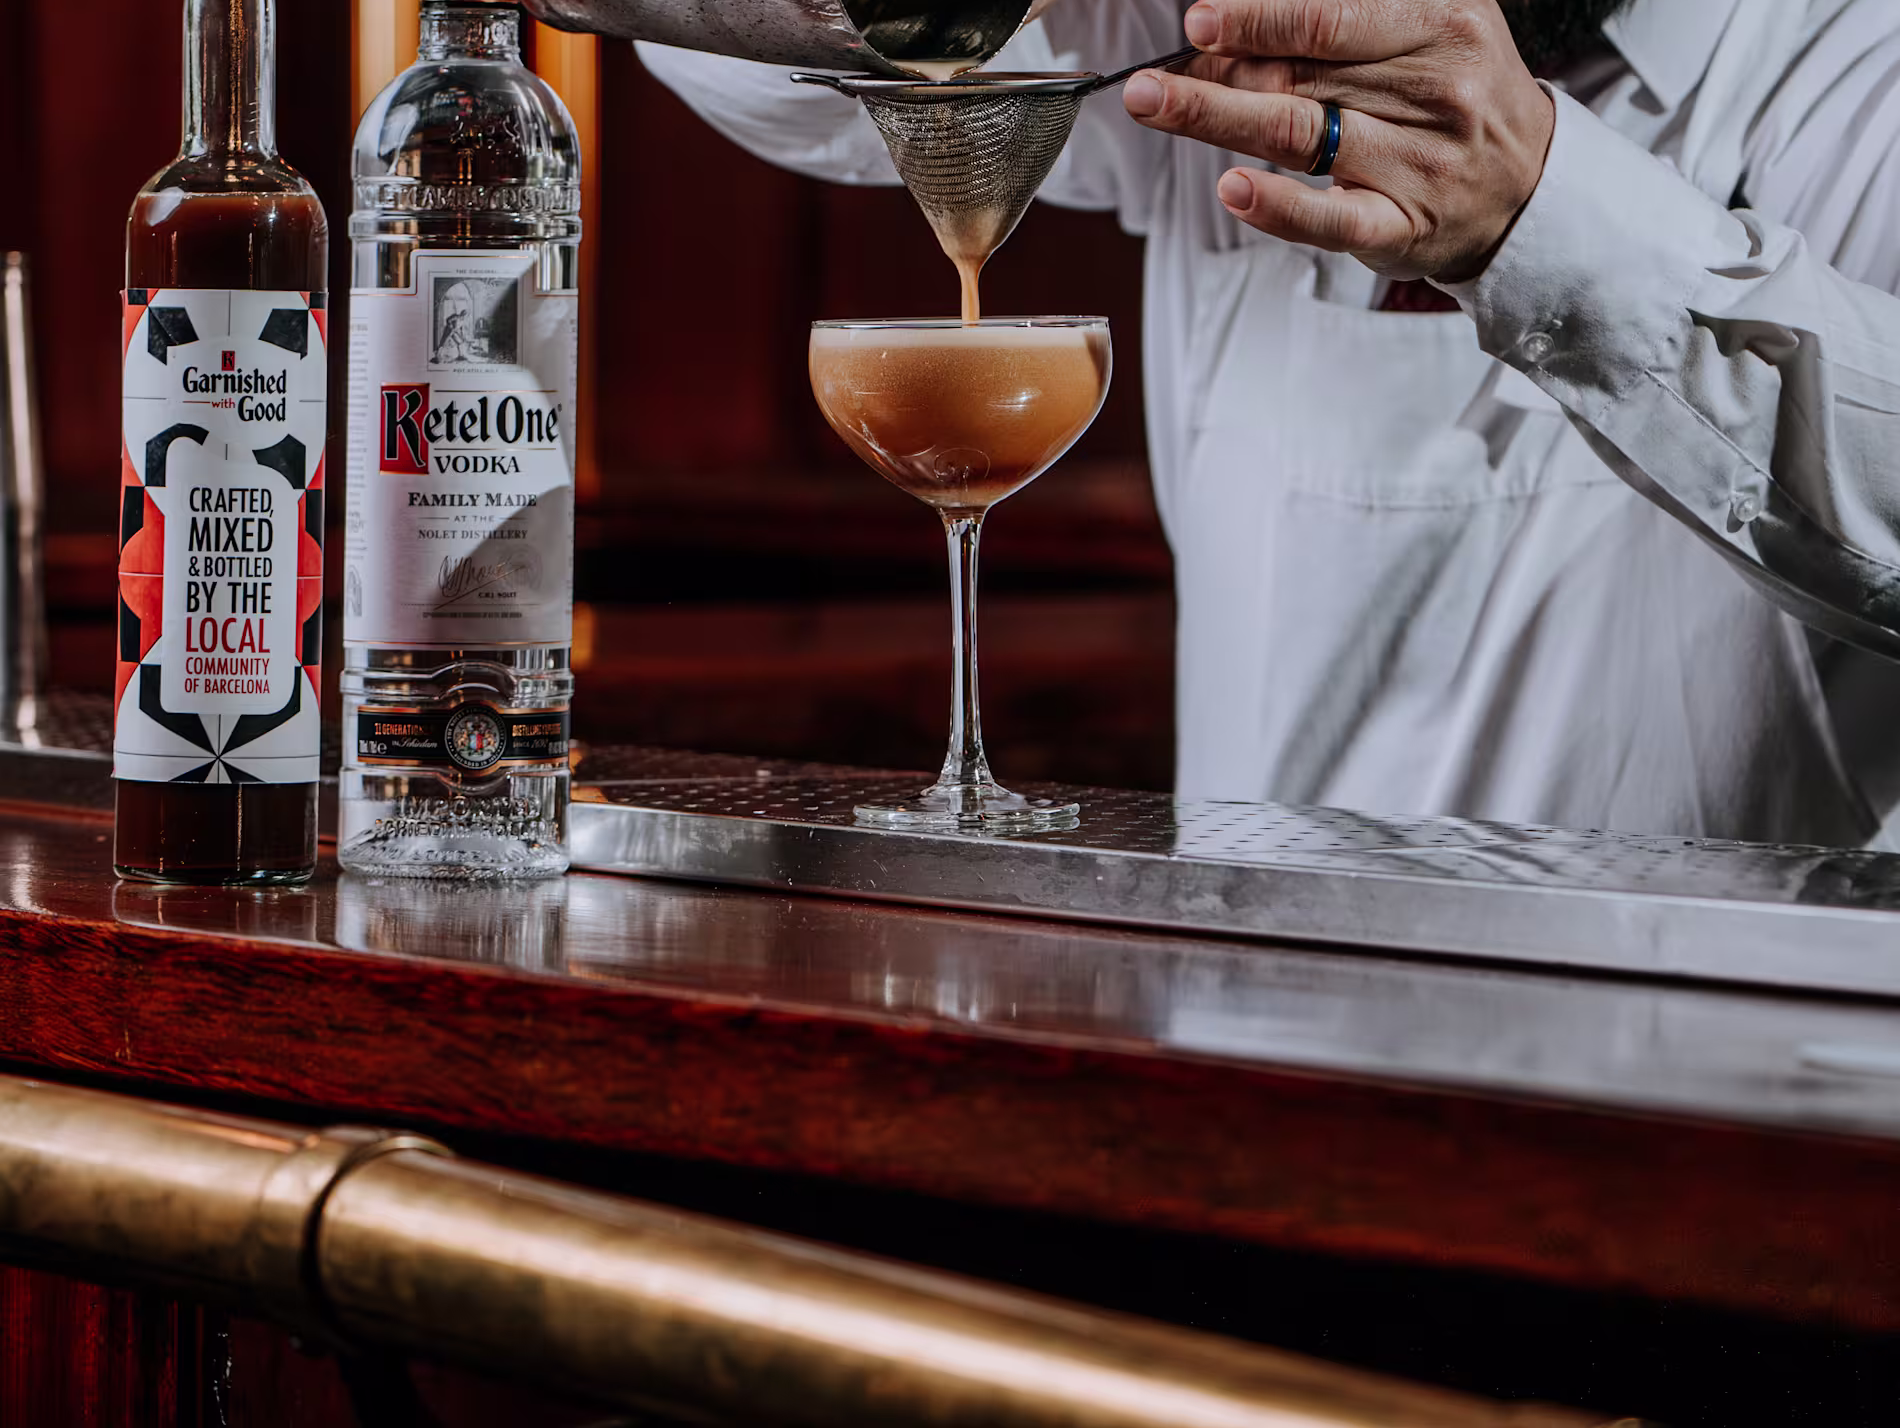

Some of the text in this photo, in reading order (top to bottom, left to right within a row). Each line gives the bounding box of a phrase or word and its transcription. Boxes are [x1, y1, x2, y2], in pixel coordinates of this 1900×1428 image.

[182, 366, 286, 394] Garnished
[211, 395, 285, 422] with Good
[383, 390, 559, 467] Ketel One
[434, 455, 520, 474] VODKA
[189, 487, 274, 518] CRAFTED,
[408, 492, 537, 507] FAMILY MADE
[454, 515, 495, 523] AT THE
[188, 516, 273, 552] MIXED
[418, 529, 528, 540] NOLET DISTILLERY
[188, 556, 272, 578] & BOTTLED
[187, 581, 272, 614] BY THE
[186, 616, 271, 653] LOCAL
[185, 656, 270, 675] COMMUNITY
[184, 677, 271, 694] OF BARCELONA
